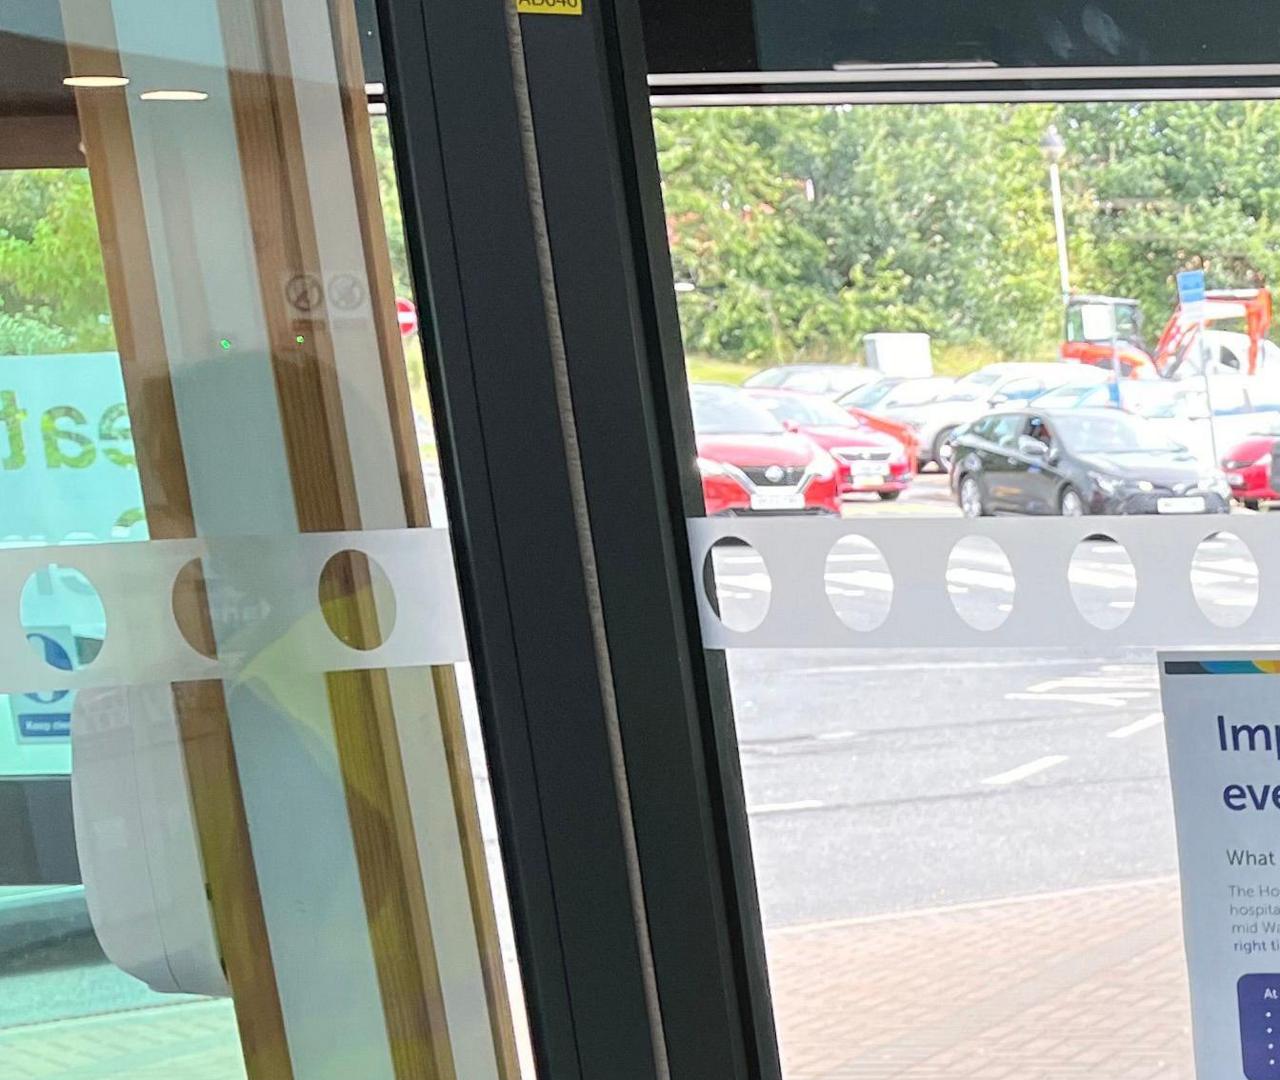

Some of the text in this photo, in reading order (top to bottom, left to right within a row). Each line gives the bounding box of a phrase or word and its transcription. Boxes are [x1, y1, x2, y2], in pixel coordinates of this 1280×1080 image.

[1226, 849, 1275, 866] What
[1234, 940, 1267, 955] right
[1264, 988, 1278, 999] At
